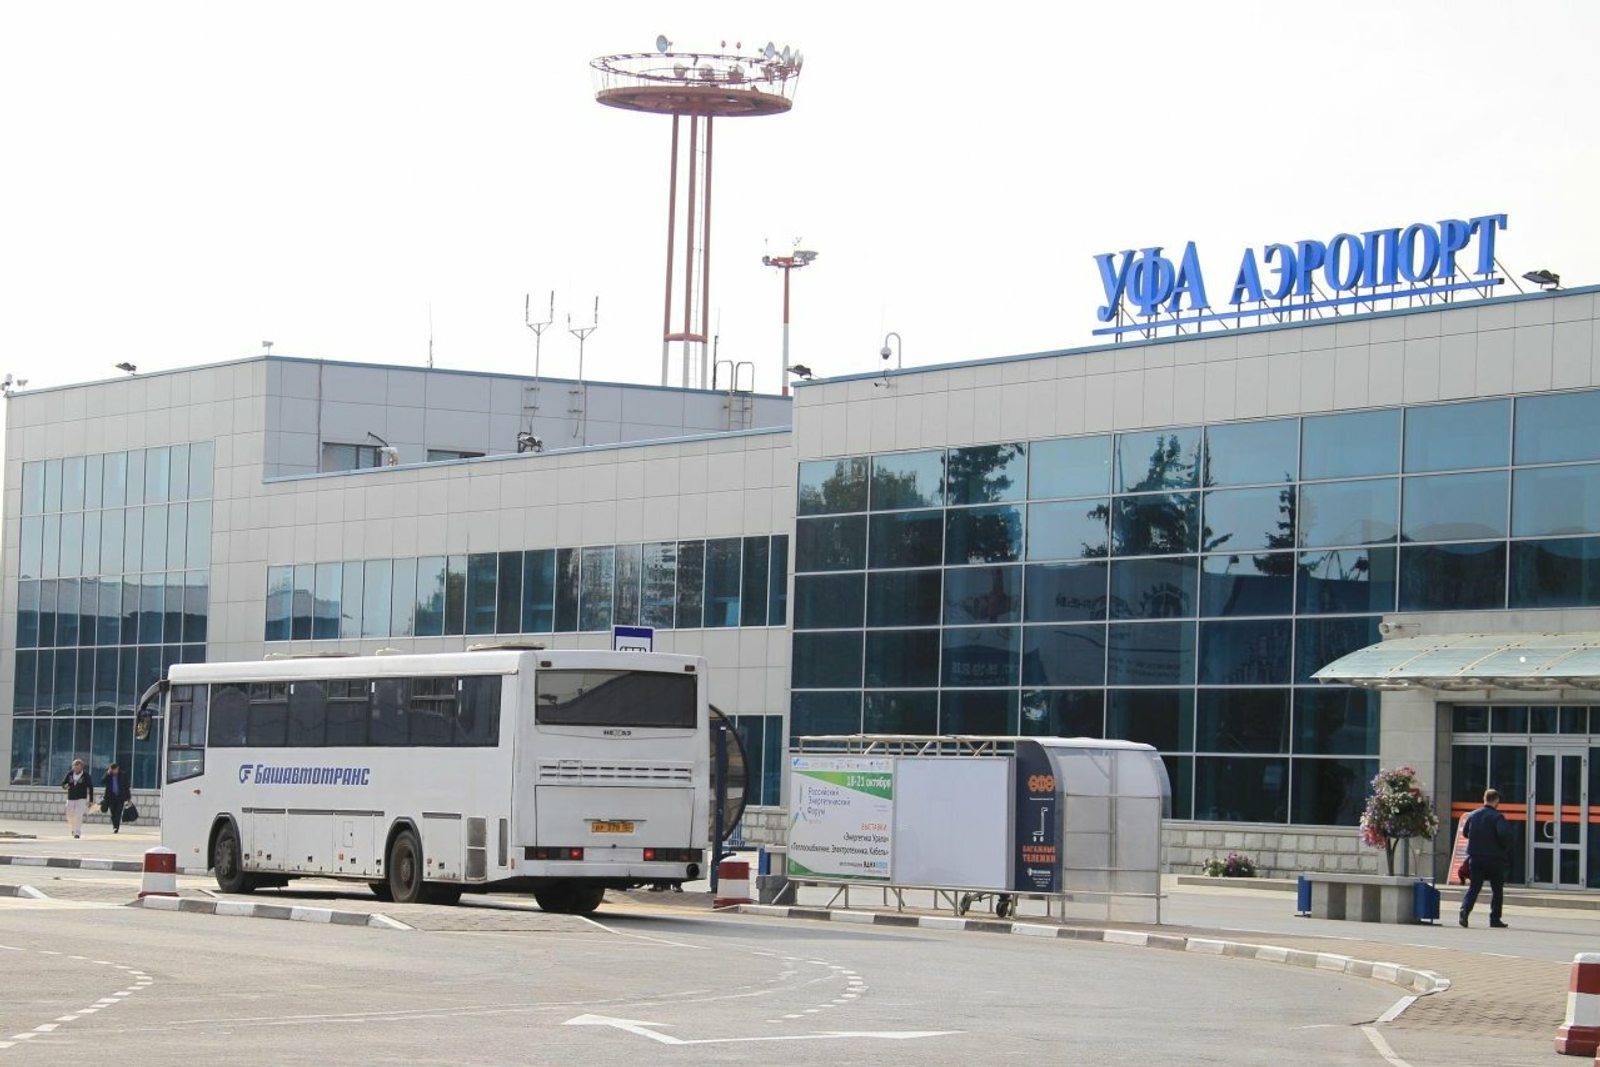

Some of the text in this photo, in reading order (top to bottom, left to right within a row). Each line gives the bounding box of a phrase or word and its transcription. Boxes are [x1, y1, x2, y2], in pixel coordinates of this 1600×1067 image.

[1092, 213, 1508, 322] УФА АЭРОПОРТ
[866, 777, 891, 790] октября
[808, 787, 839, 796] Российский
